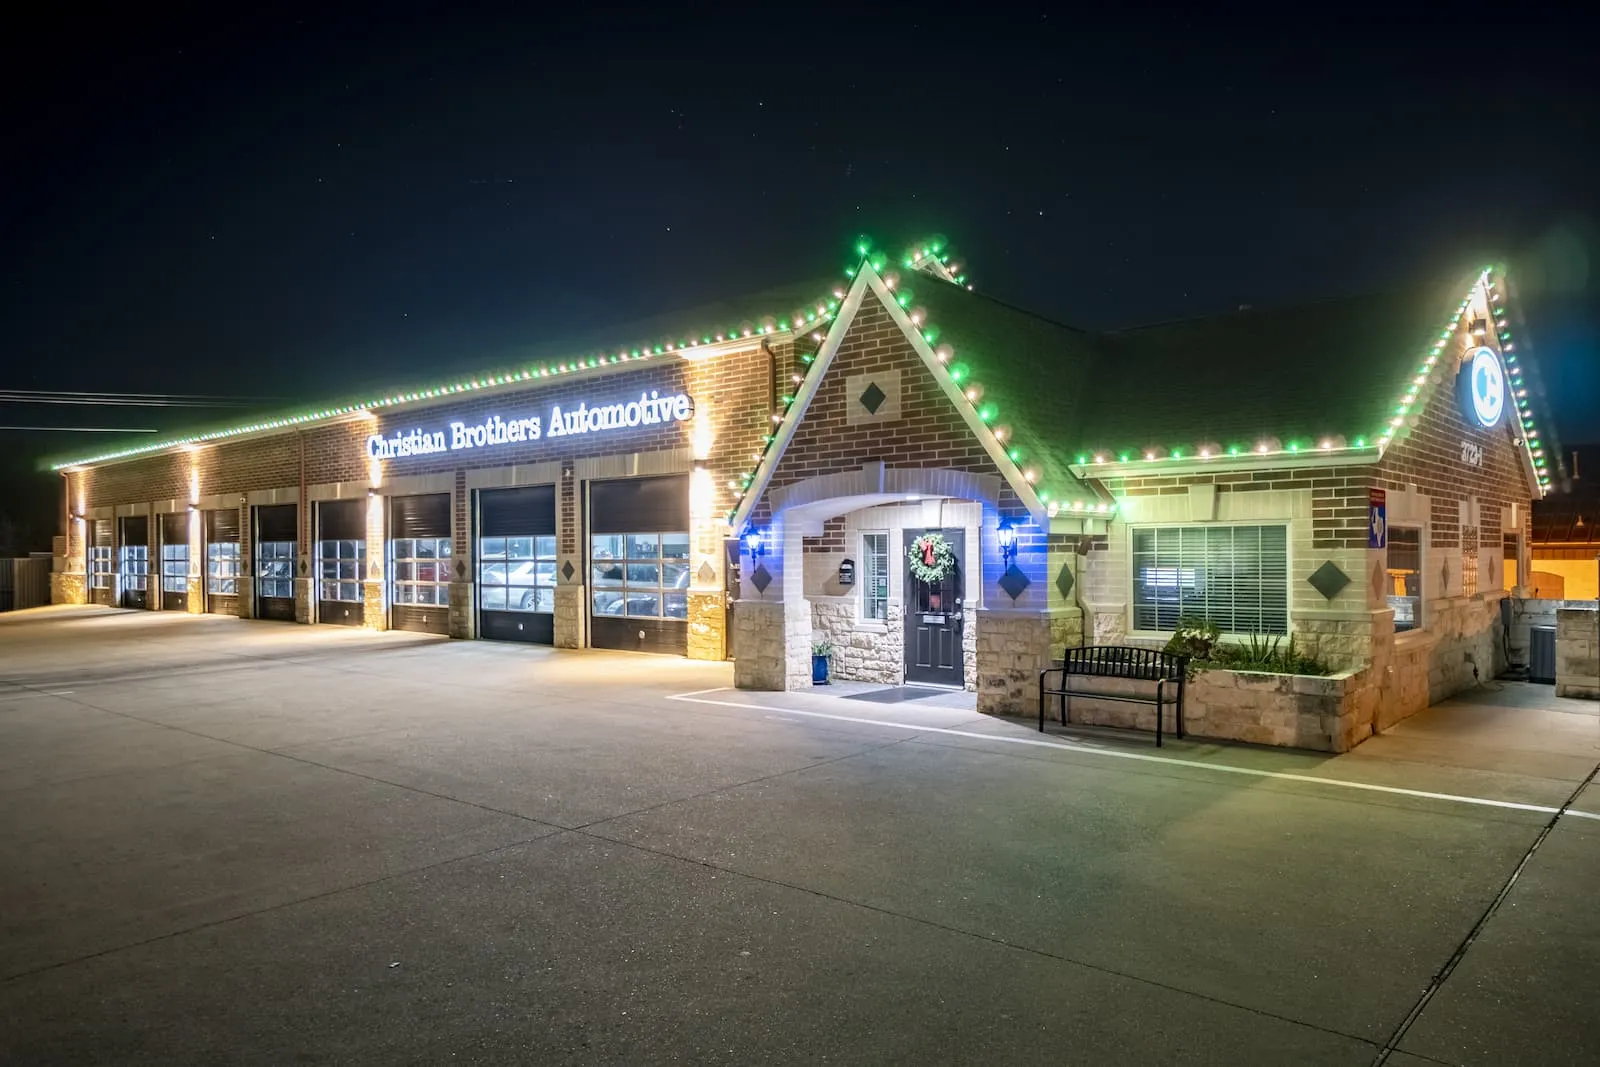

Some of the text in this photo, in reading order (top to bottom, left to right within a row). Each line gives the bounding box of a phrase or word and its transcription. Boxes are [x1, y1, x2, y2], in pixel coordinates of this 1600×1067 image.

[366, 390, 690, 459] Christian Brothers Automotive
